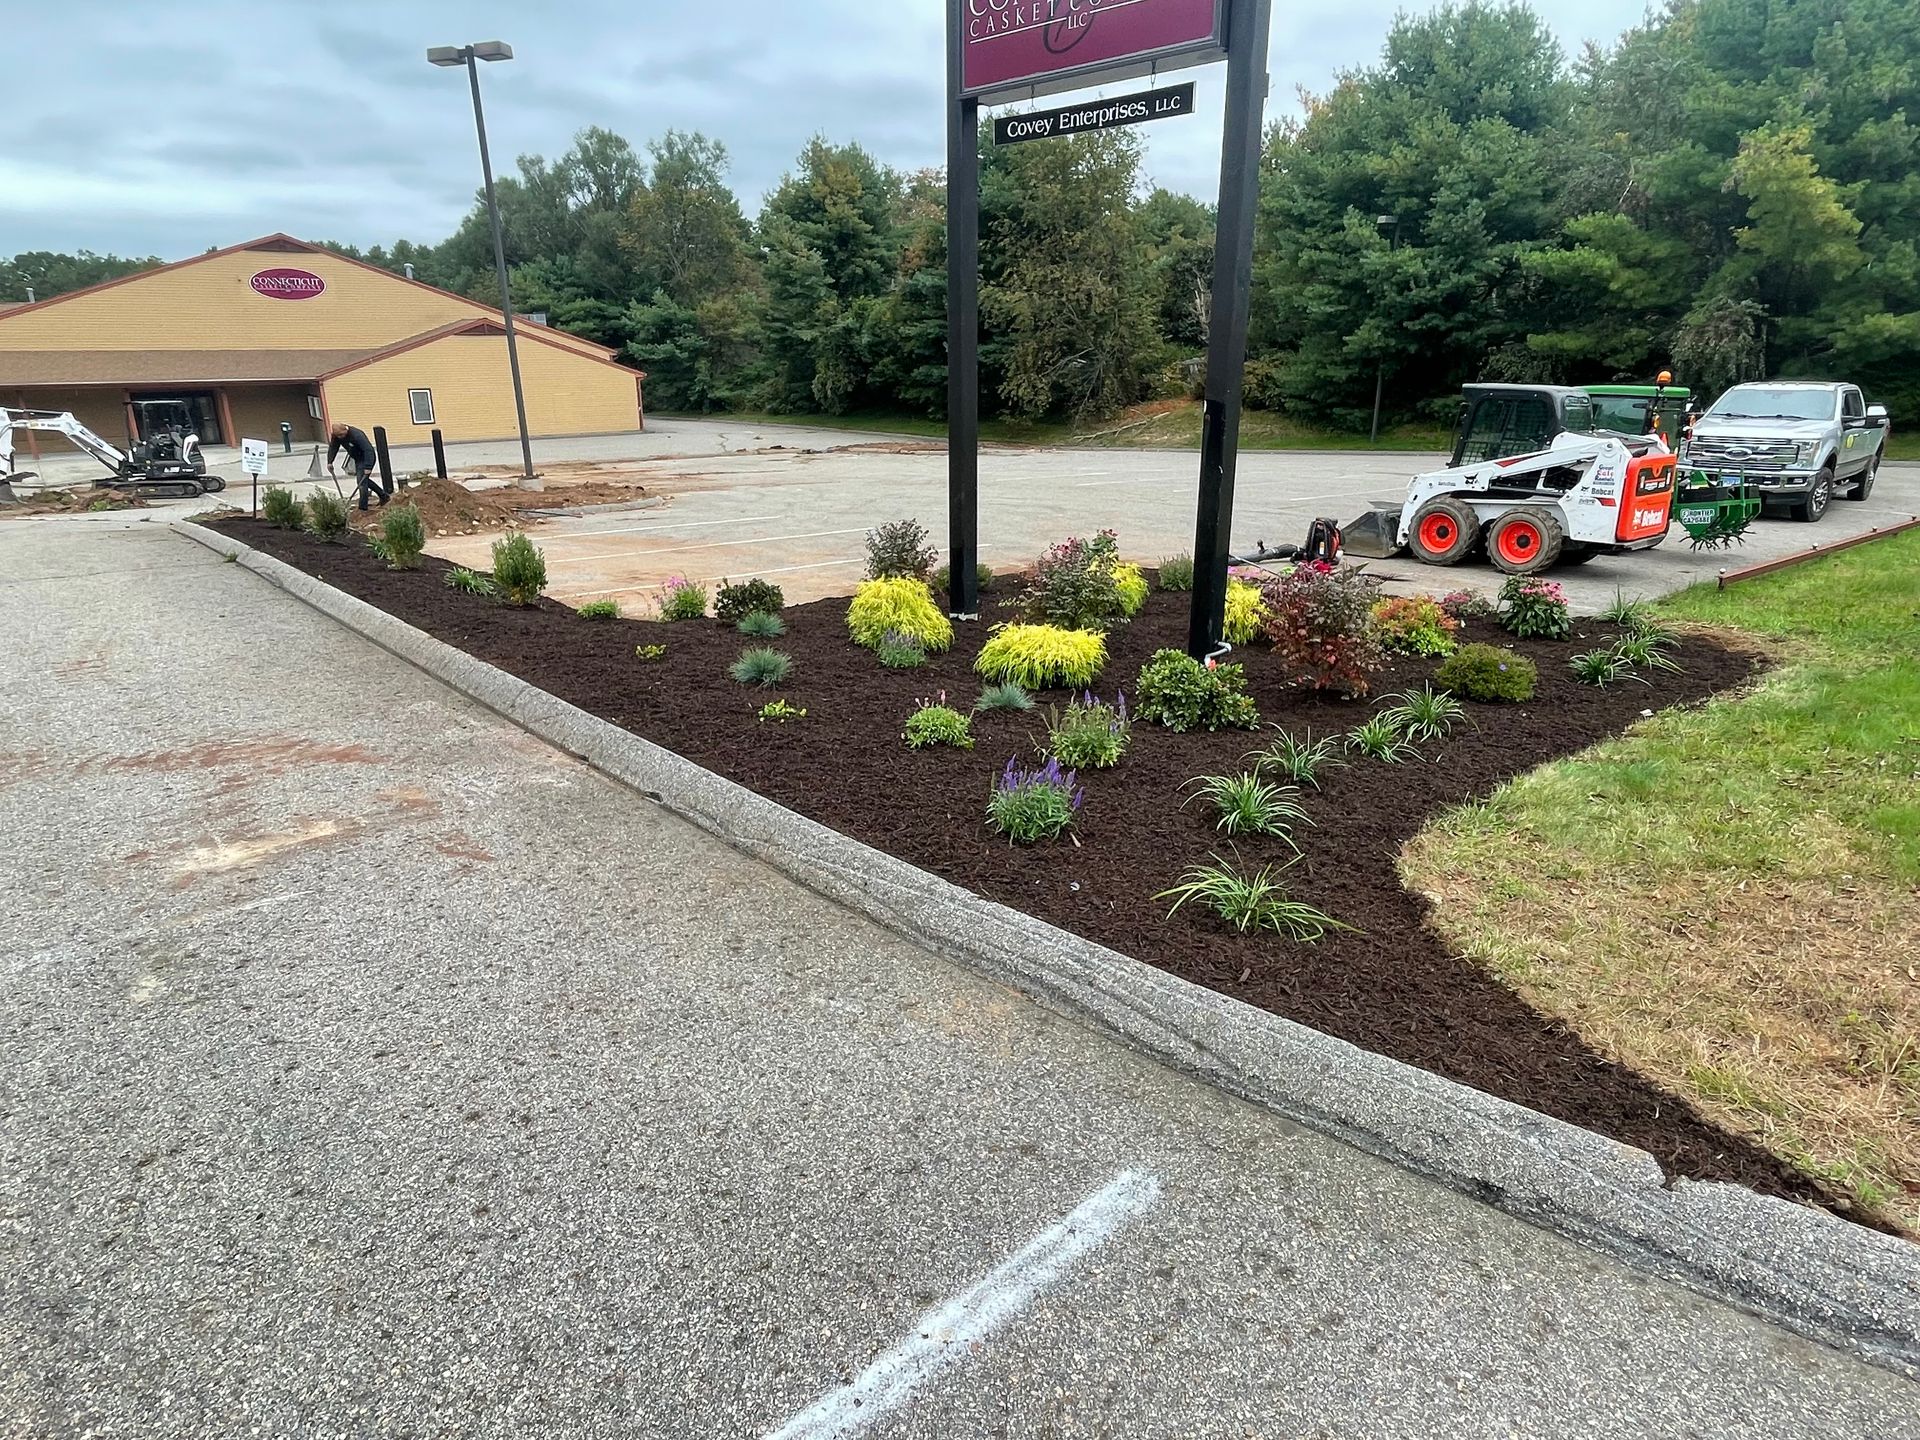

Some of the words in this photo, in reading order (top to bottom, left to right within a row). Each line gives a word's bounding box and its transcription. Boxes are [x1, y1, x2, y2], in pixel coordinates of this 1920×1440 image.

[970, 0, 1057, 37] CASKET
[1068, 12, 1088, 29] LLC
[1007, 118, 1054, 138] Covey
[1059, 101, 1149, 130] Enterprises,
[1155, 96, 1181, 113] LLC
[253, 277, 320, 286] CONNECTICUT
[1591, 487, 1614, 496] Bobcat
[1641, 508, 1664, 527] Bobcat
